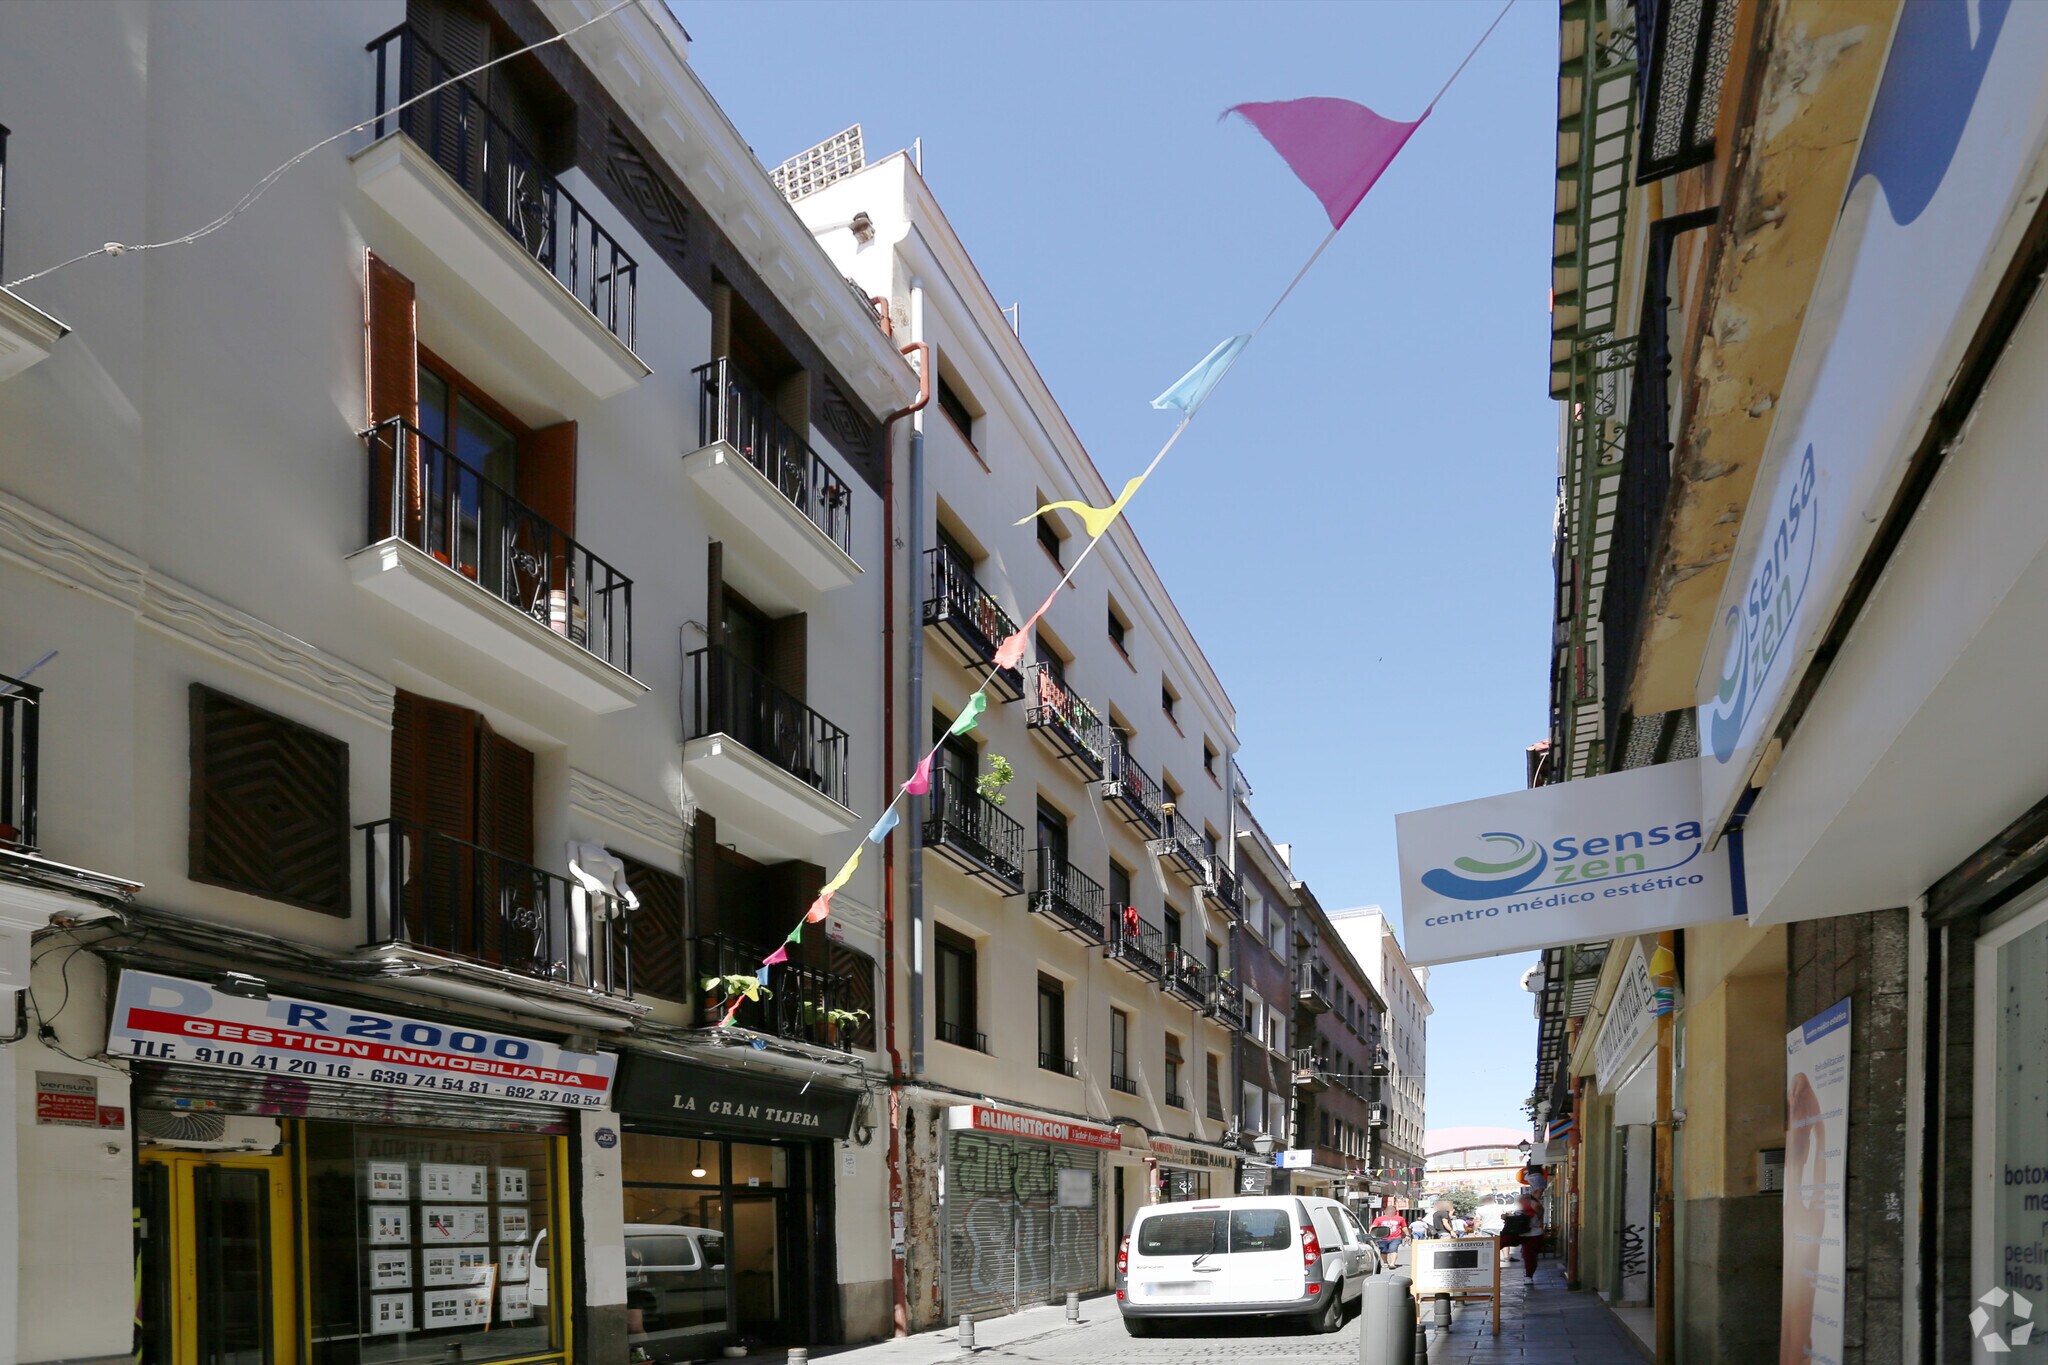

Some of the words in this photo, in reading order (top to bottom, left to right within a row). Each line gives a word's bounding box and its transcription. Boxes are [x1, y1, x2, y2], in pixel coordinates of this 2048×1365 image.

[1752, 575, 1792, 693] zen
[1554, 853, 1645, 884] zen
[1425, 905, 1500, 927] centro
[1507, 890, 1595, 914] médico
[1603, 874, 1704, 898] estético
[287, 1003, 329, 1031] R
[346, 1015, 530, 1060] 2000
[183, 1020, 370, 1056] GESTION
[383, 1048, 582, 1085] INMOBILIARIA
[40, 1081, 94, 1092] verisure
[130, 1038, 176, 1060] TLF.
[195, 1047, 244, 1066] 910
[251, 1055, 278, 1070] 41
[288, 1058, 317, 1074] 20
[326, 1063, 350, 1079] 16
[370, 1069, 407, 1085] 639
[414, 1074, 436, 1088] 74
[441, 1078, 464, 1092] 54
[469, 1081, 488, 1094] 81
[505, 1085, 535, 1100] 692
[539, 1089, 559, 1102] 37
[562, 1092, 580, 1105] 03
[583, 1095, 600, 1106] 54
[40, 1094, 94, 1105] Alarma
[672, 1094, 696, 1111] LA
[709, 1101, 760, 1119] GRAN
[765, 1108, 820, 1127] TIJERA
[598, 1133, 613, 1142] ADT
[980, 1110, 1070, 1140] ALIMENTACION
[2004, 1265, 2043, 1291] hilos
